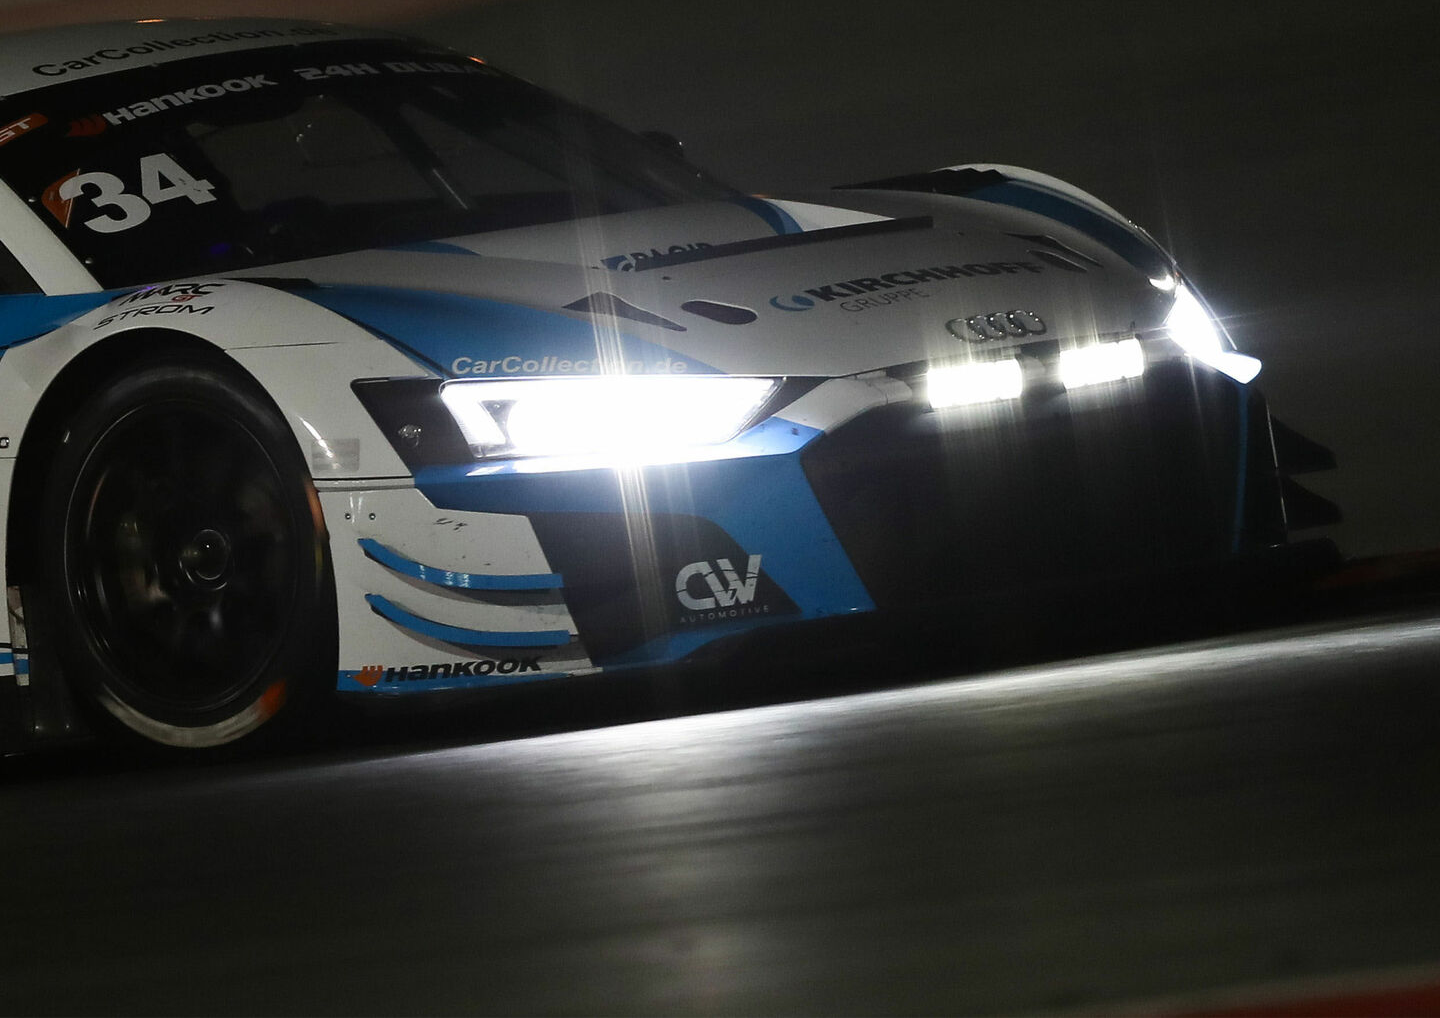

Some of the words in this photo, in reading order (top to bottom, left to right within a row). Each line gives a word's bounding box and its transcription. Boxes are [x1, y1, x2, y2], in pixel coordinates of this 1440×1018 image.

[293, 62, 382, 81] 24H
[59, 152, 218, 234] 34
[804, 262, 1046, 302] KIRCHHOFF
[839, 287, 931, 313] GRUPPE
[93, 304, 215, 330] STROM
[451, 355, 689, 375] CarCollectn.de
[675, 553, 763, 611] CW
[679, 604, 769, 623] AUTOMOTIVE
